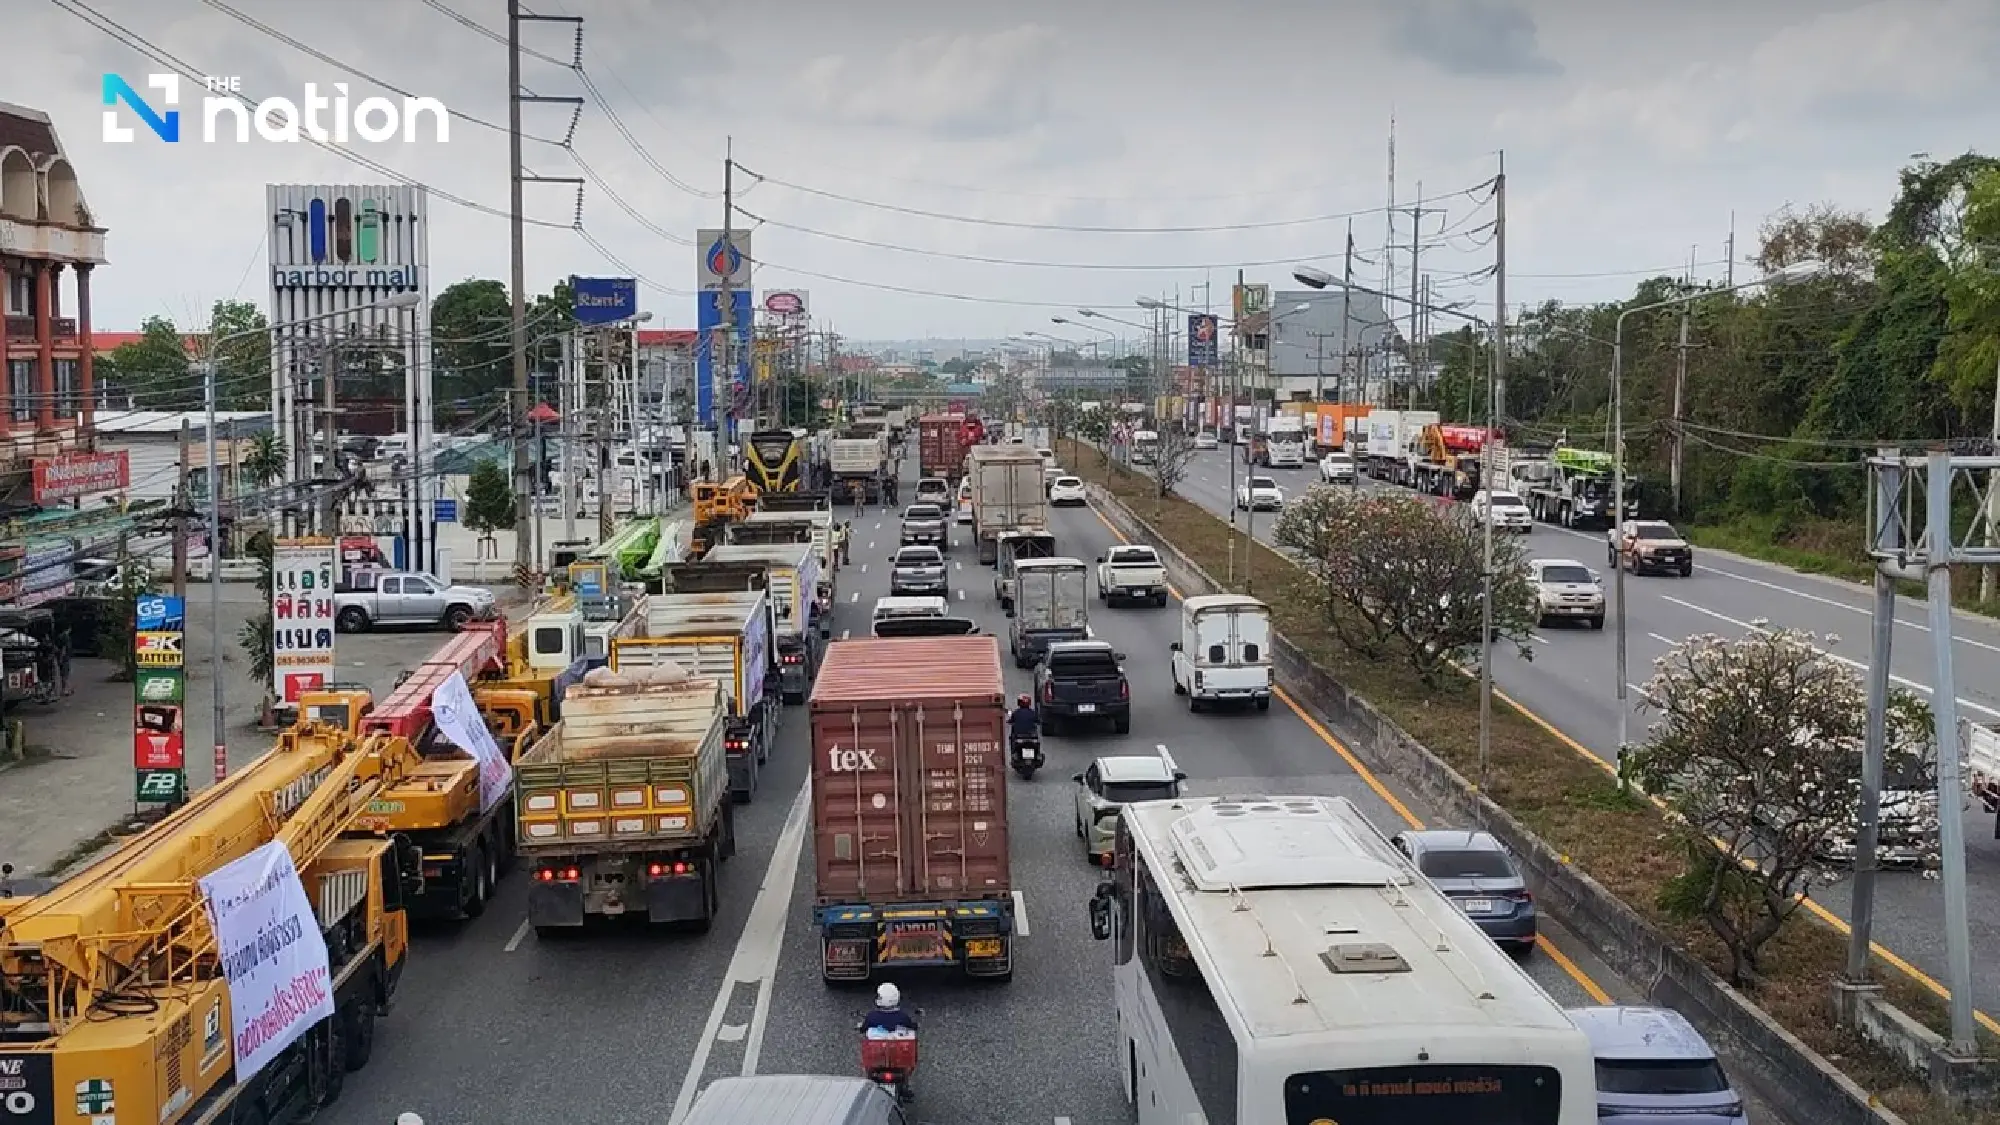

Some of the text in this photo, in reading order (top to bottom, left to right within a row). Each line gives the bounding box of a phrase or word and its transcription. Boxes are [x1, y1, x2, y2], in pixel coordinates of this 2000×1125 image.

[273, 265, 418, 288] harbor mall
[276, 562, 332, 591] แอร์
[137, 599, 166, 617] GS
[275, 592, 332, 619] ฟิล์ม
[137, 653, 183, 663] BATTERY
[829, 743, 878, 772] tex
[142, 773, 177, 789] FB
